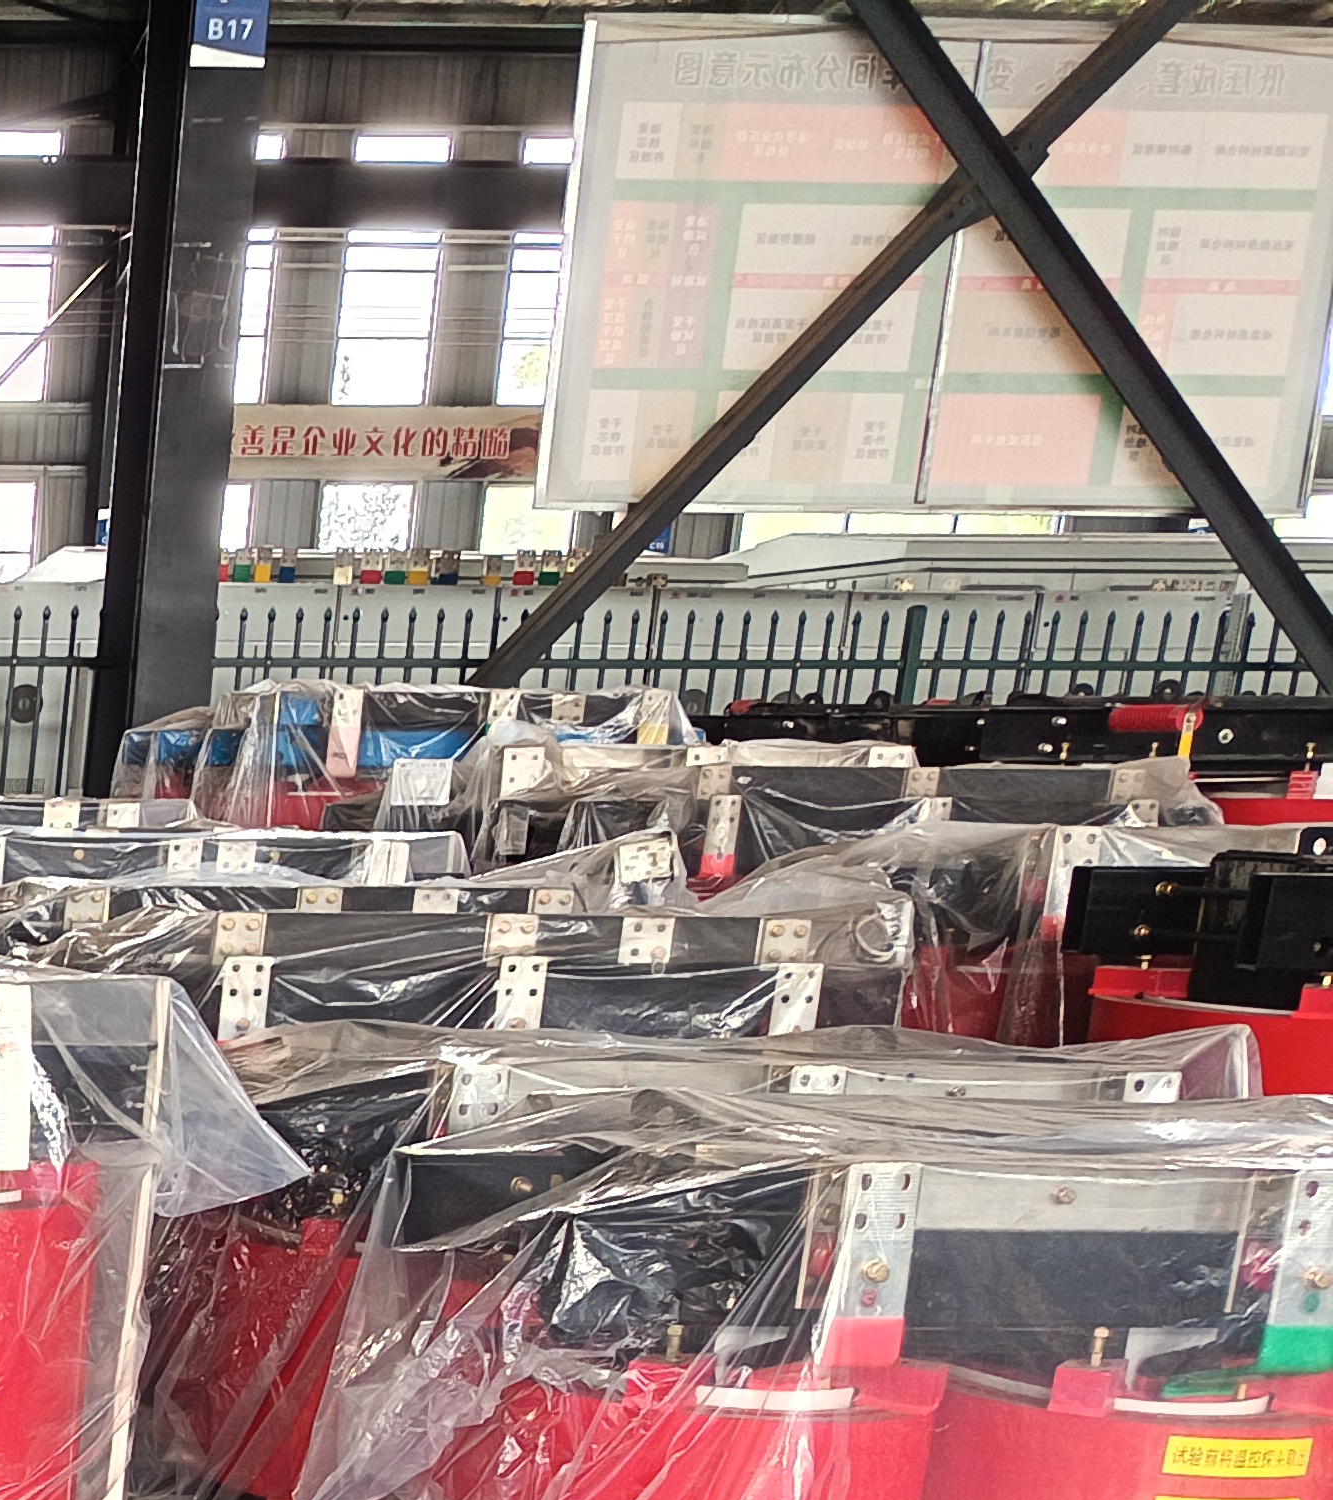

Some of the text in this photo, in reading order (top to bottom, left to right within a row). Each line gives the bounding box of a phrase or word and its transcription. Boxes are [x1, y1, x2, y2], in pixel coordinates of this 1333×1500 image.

[207, 17, 254, 42] B17
[231, 424, 511, 459] 善是企业文化的精髓
